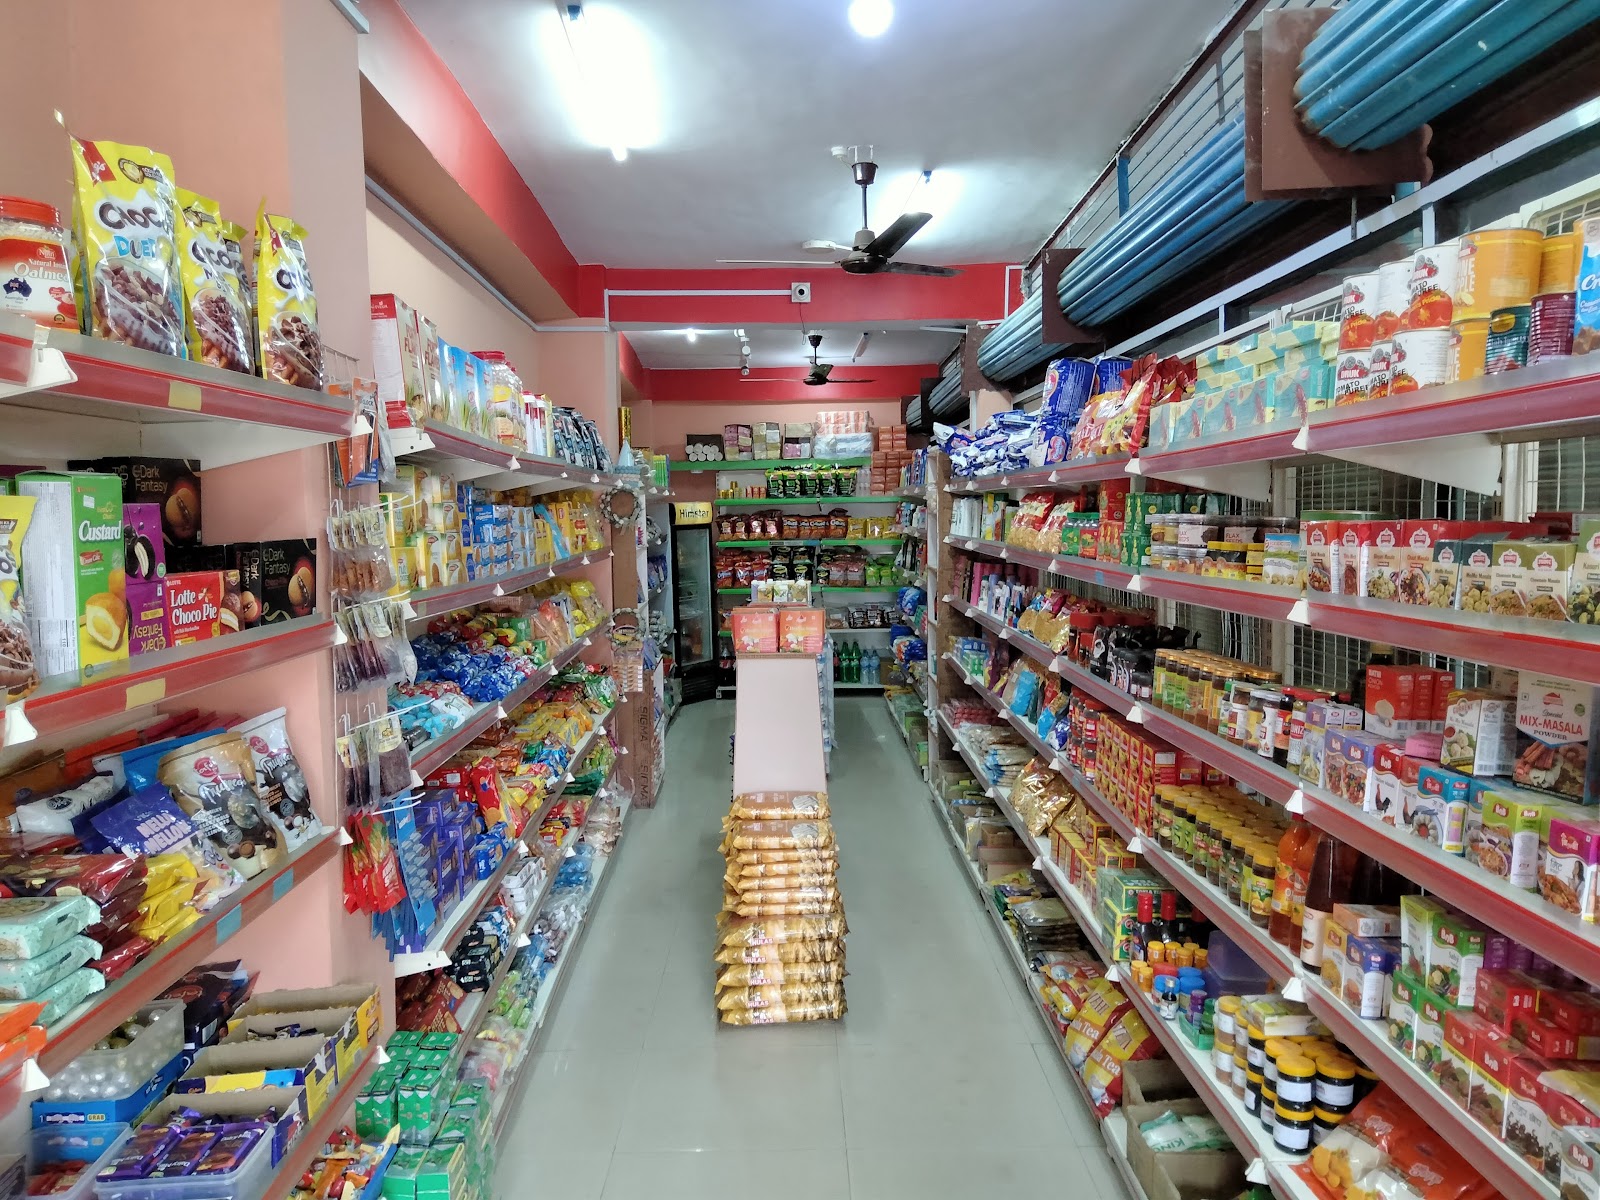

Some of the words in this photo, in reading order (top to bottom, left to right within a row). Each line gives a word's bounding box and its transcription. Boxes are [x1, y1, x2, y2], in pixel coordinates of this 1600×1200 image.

[1340, 368, 1360, 379] DRUK
[140, 465, 160, 479] Dark
[135, 478, 168, 494] Fantasy
[679, 508, 709, 519] Himstar
[79, 519, 122, 542] Custard
[268, 548, 284, 561] Dark
[251, 556, 260, 580] Dark
[264, 561, 291, 575] Fantasy
[170, 588, 196, 608] Lotte
[171, 607, 201, 627] Choco
[202, 602, 218, 621] Pie
[133, 622, 163, 641] Fantasy
[140, 637, 160, 652] Dark
[1452, 703, 1474, 715] CURRENT
[1542, 708, 1564, 719] Special
[639, 706, 649, 742] SIGMA
[1519, 713, 1583, 736] MIX-MASALA
[1533, 729, 1568, 741] POWDER
[751, 938, 773, 946] HULAS
[1440, 927, 1455, 945] BnB
[750, 978, 771, 986] HULAS
[747, 1000, 769, 1008] HULAS
[1425, 1004, 1440, 1022] BnB
[1083, 1021, 1100, 1040] Tea
[1102, 1055, 1121, 1076] Tea
[1484, 1050, 1499, 1072] BnB
[87, 1113, 105, 1121] GRAB
[1572, 1144, 1590, 1168] BnB
